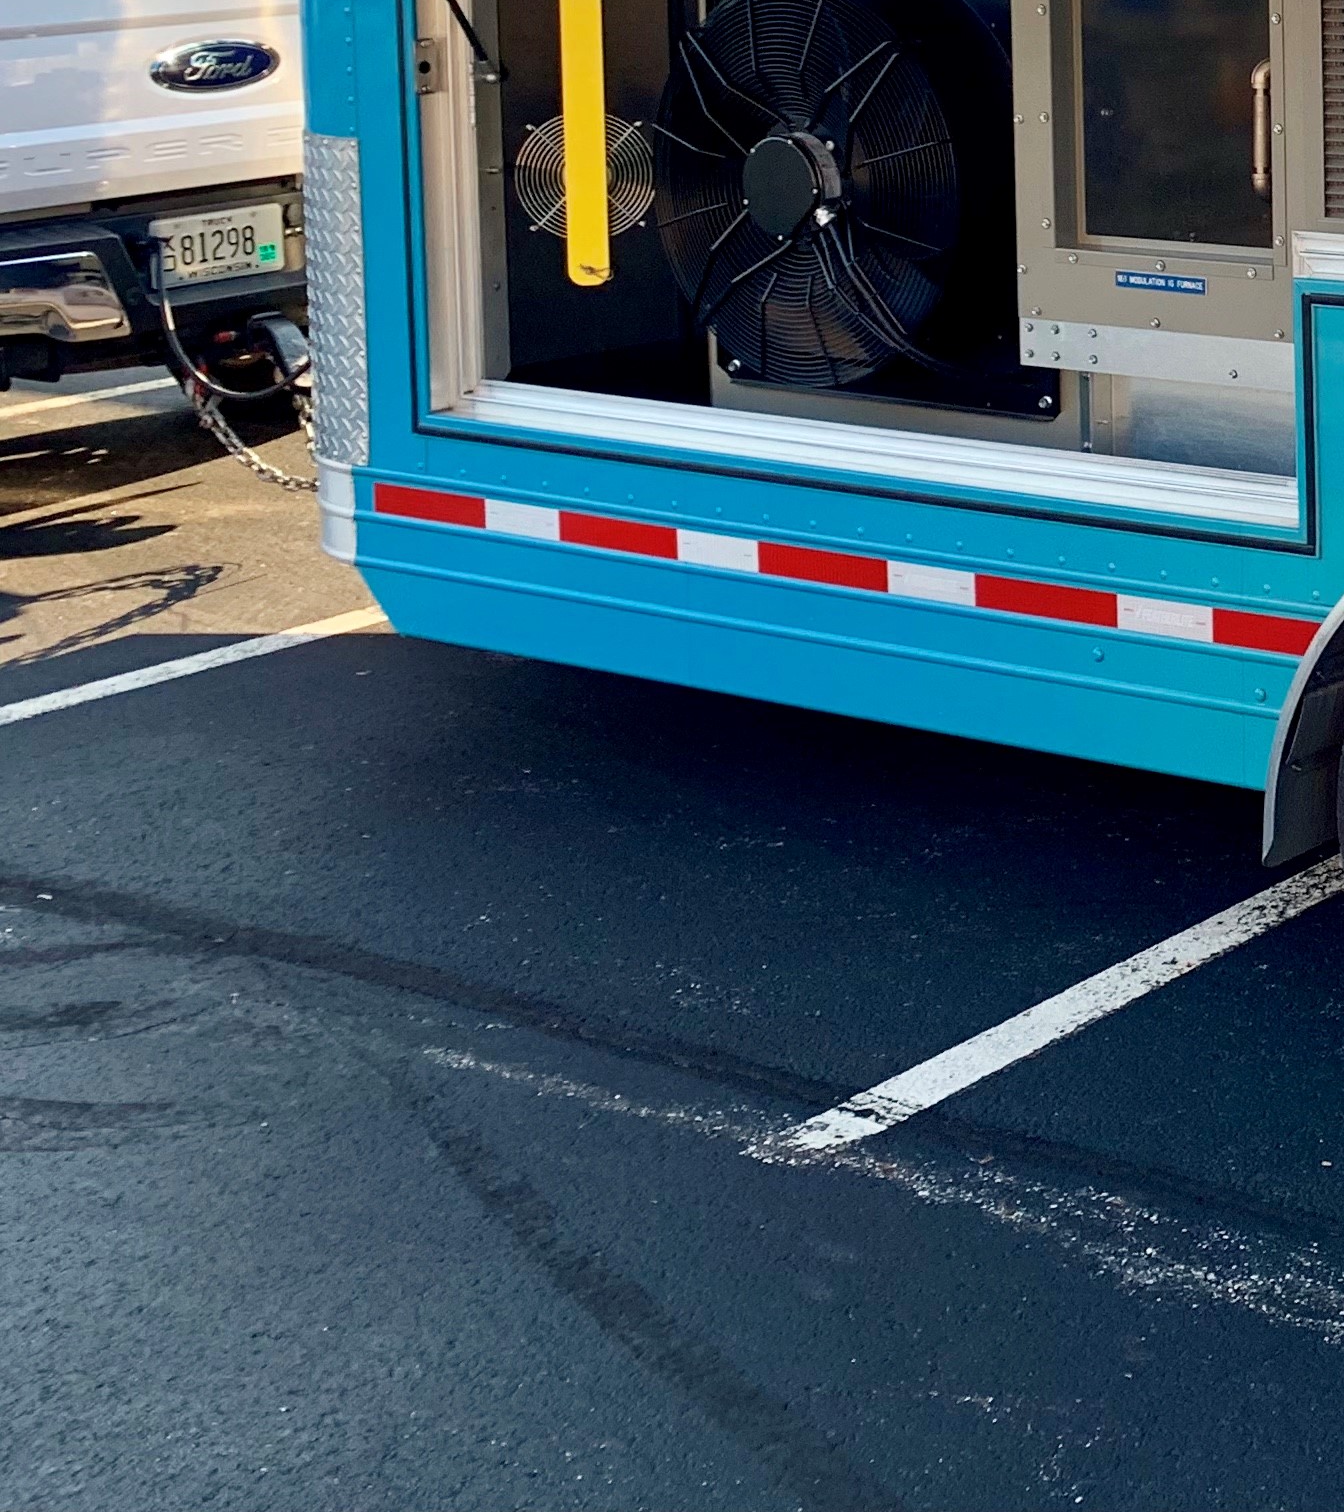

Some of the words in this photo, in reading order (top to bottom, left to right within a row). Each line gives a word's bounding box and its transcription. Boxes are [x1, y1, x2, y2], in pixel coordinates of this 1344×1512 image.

[182, 49, 253, 82] Ford
[202, 217, 232, 226] TRUCK
[181, 225, 255, 266] 81298
[187, 262, 252, 279] WISCONSIN
